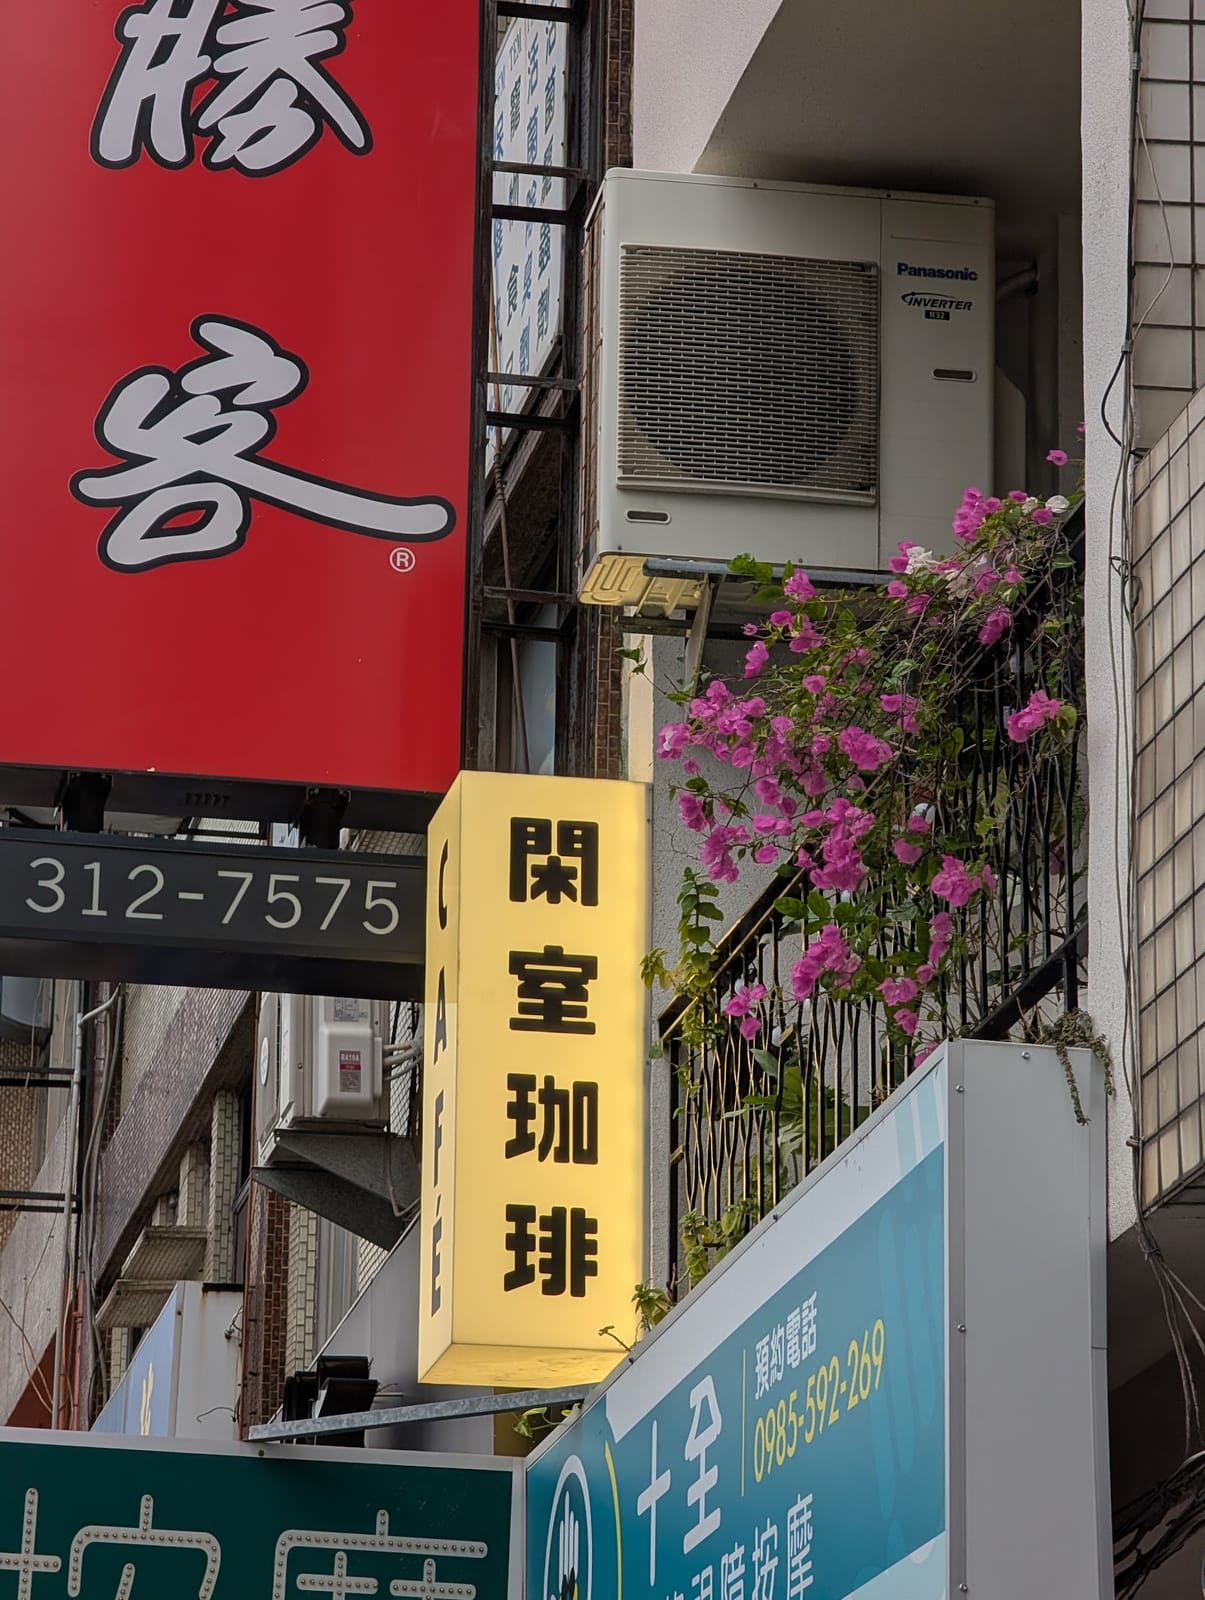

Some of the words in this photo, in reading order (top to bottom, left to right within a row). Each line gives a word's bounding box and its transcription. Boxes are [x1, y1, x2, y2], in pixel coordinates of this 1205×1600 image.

[897, 262, 978, 281] Panasonic
[907, 296, 973, 311] INVERTER
[25, 857, 400, 936] 312-7575
[503, 816, 599, 1298] 閑室珈琲
[755, 1291, 817, 1400] 預約電話
[754, 1319, 885, 1483] 0985-592-269
